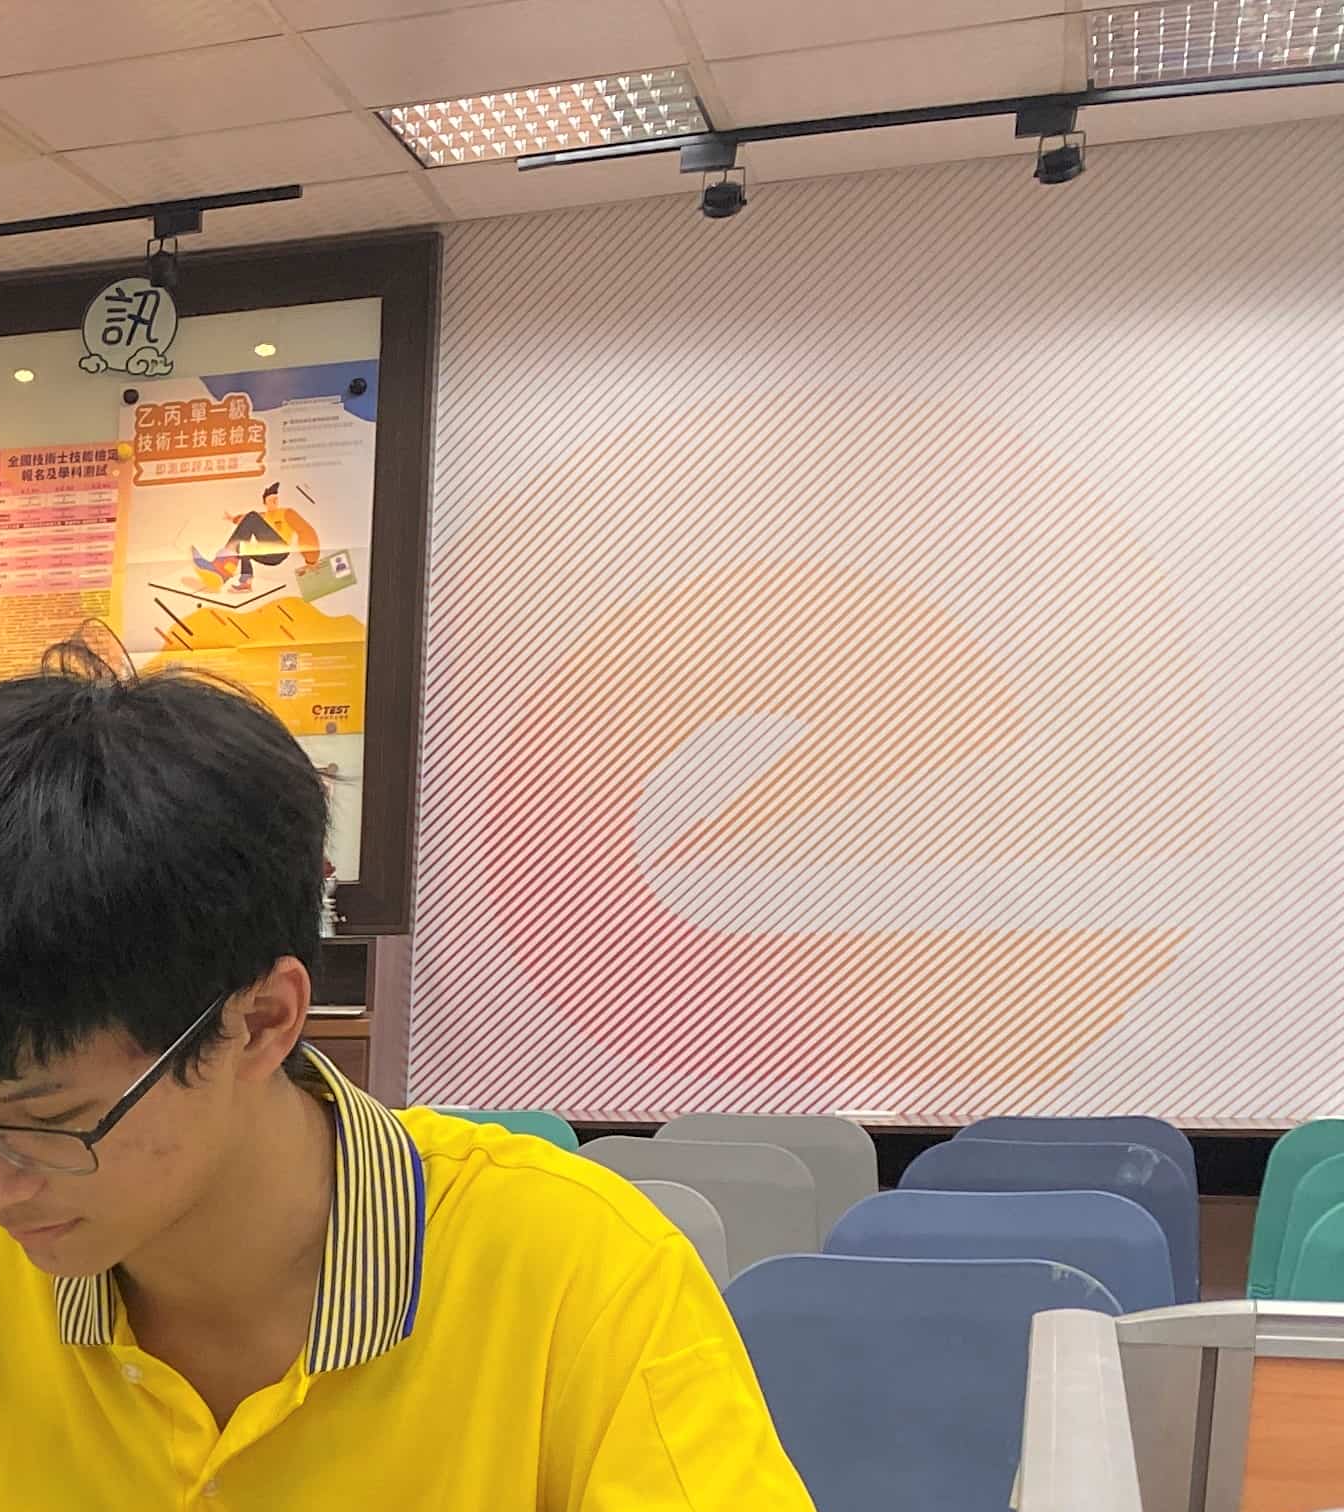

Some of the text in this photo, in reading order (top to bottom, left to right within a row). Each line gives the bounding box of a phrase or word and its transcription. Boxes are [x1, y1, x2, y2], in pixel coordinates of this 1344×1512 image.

[101, 286, 161, 348] 訊
[137, 424, 265, 454] 技術士技能檢定
[8, 449, 120, 468] 全國技術士技能檢定
[21, 464, 108, 482] 報名及學科測試
